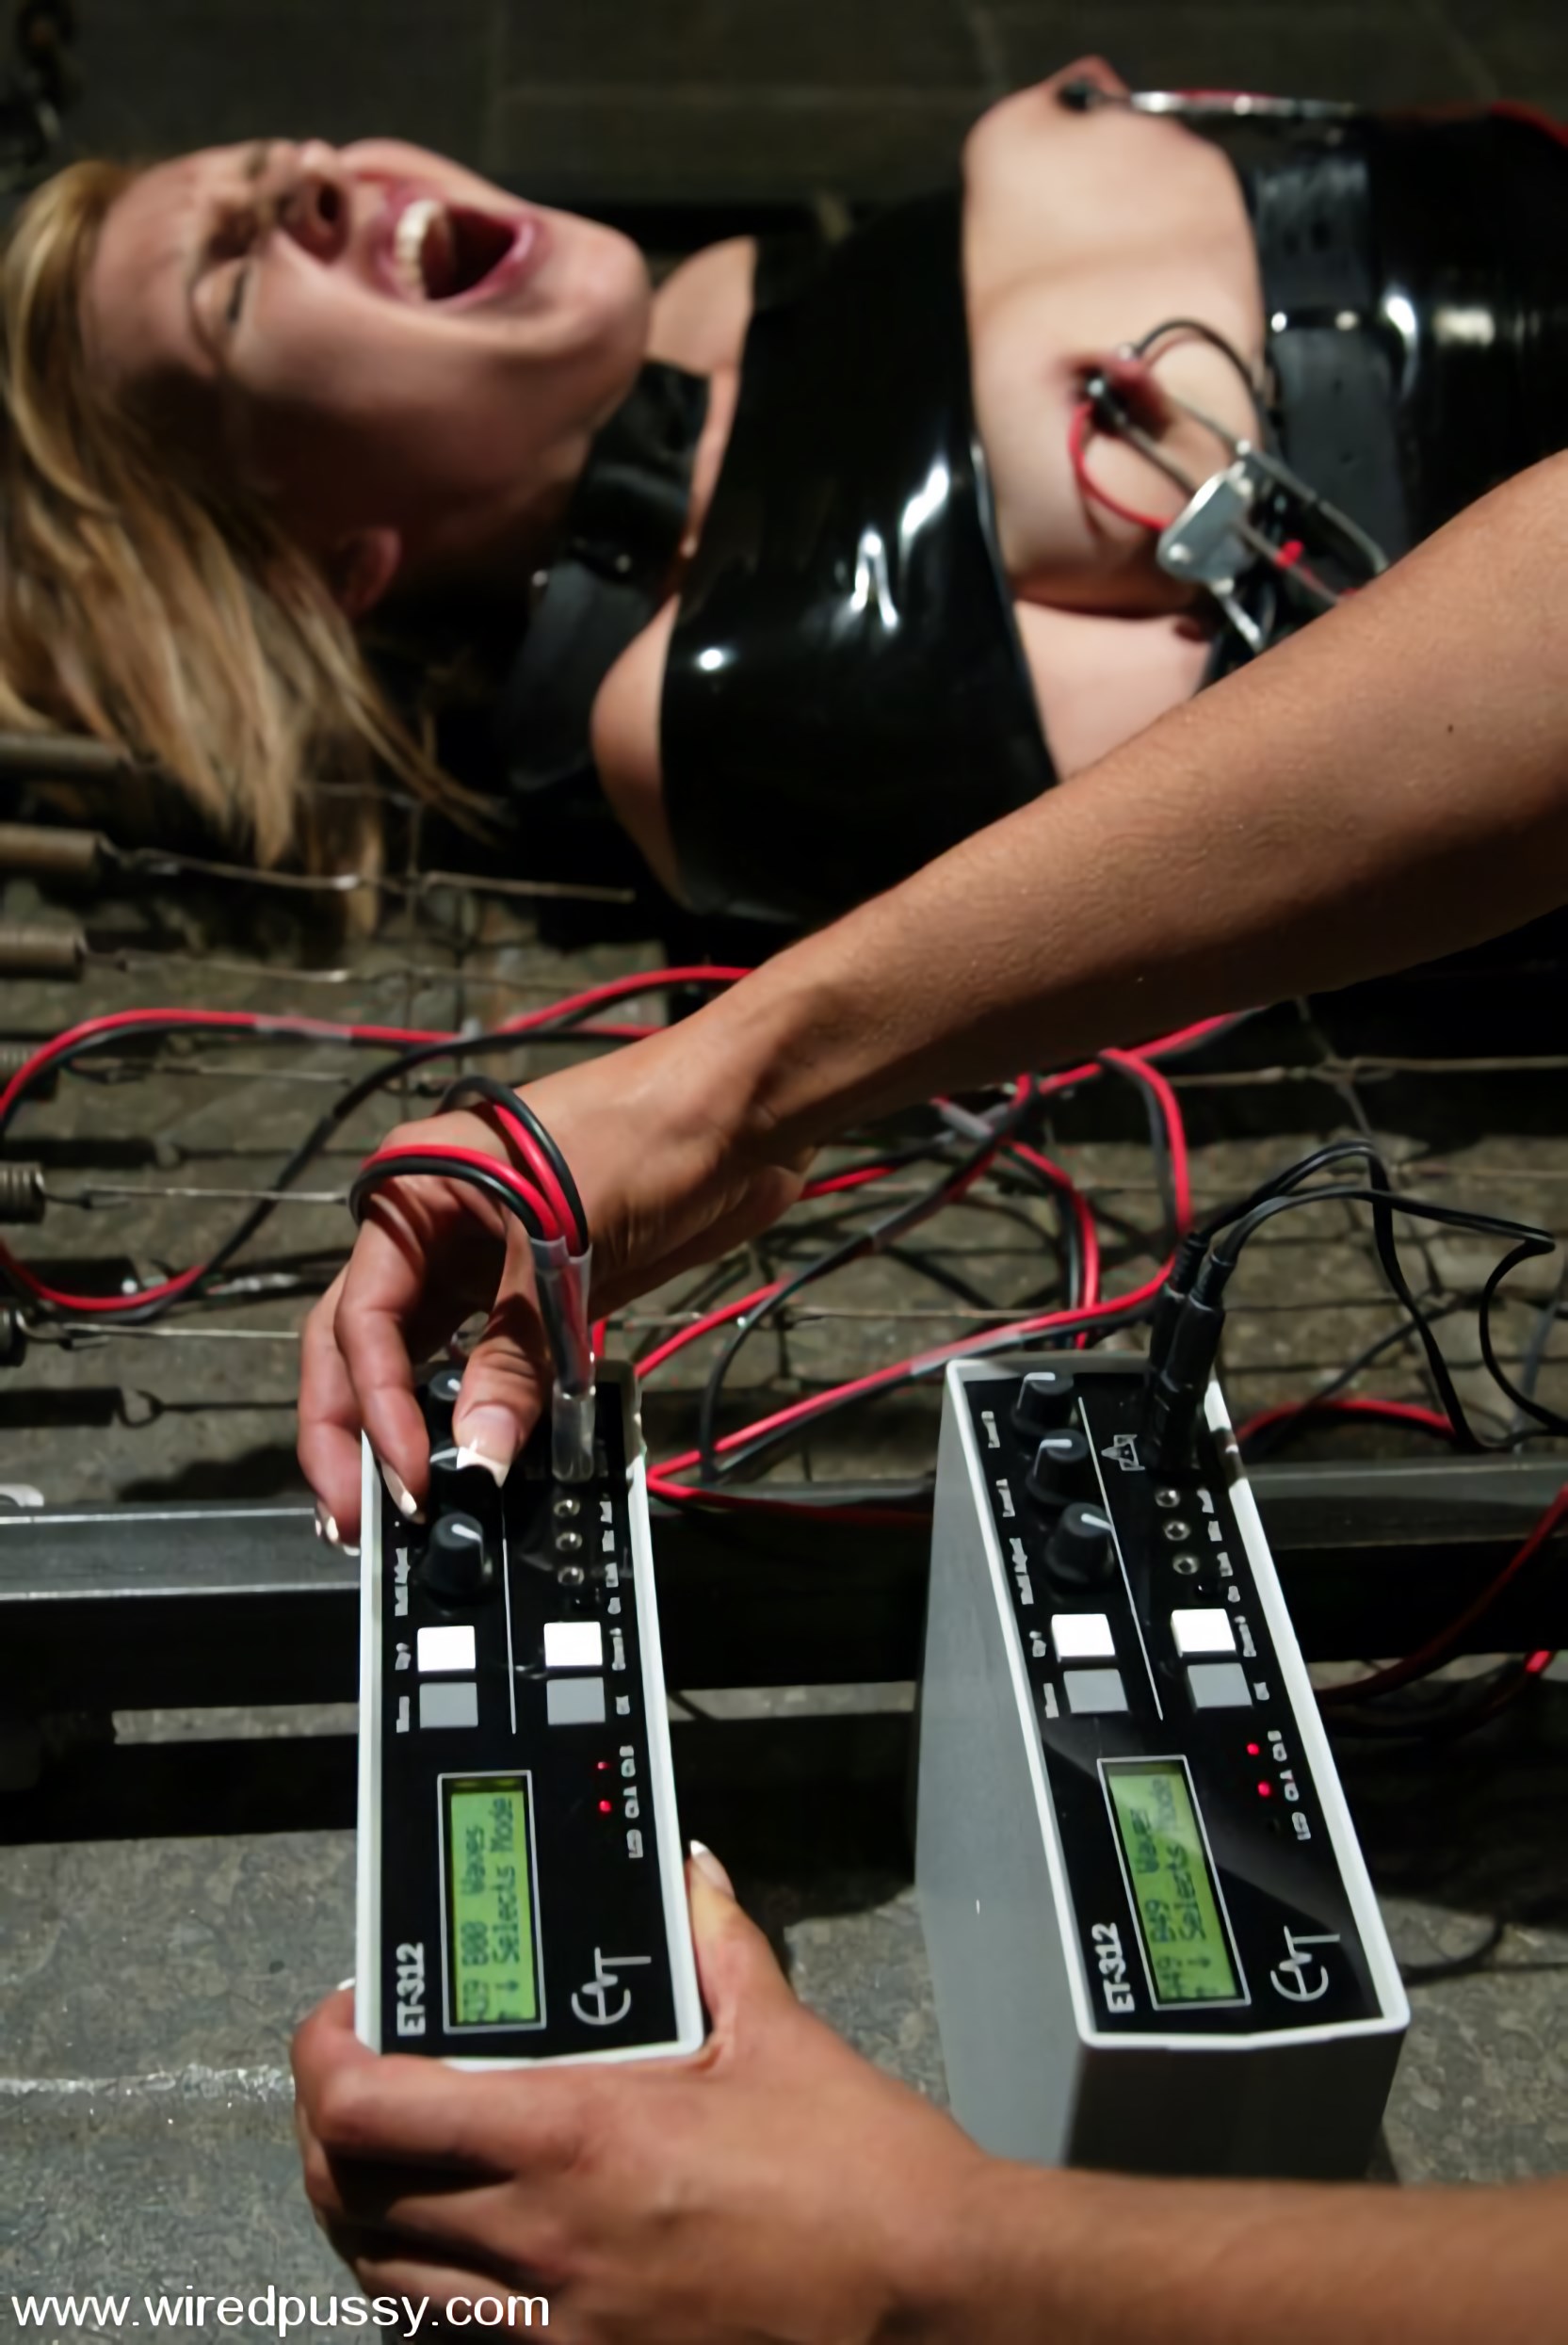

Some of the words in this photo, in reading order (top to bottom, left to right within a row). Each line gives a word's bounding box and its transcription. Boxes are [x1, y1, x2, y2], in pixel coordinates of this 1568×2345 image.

[492, 1865, 521, 1964] Selects
[396, 1942, 427, 2036] ET-312
[1091, 1923, 1135, 2013] ET-312
